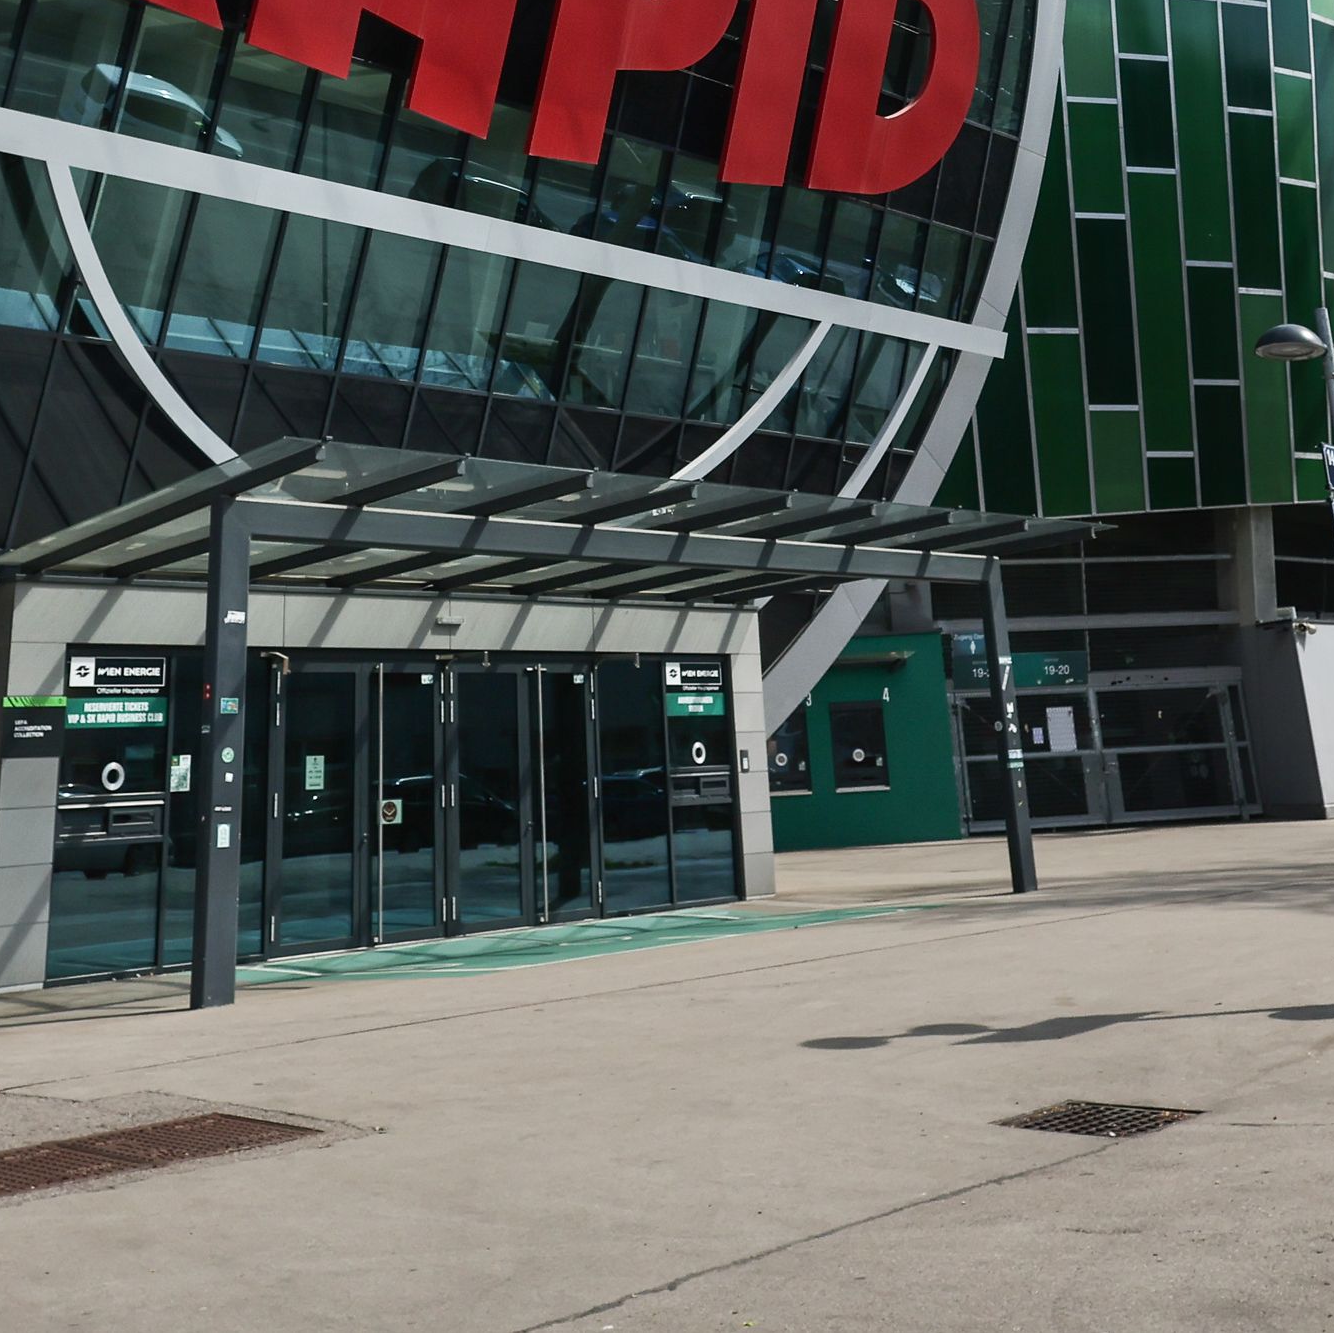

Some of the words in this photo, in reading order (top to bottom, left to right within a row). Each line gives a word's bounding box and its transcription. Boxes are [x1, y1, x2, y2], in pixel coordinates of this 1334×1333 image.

[97, 667, 121, 676] WIEN
[124, 667, 161, 676] ENERGIE
[1044, 665, 1070, 675] 19-20
[805, 692, 812, 707] 3
[883, 687, 890, 703] 4
[125, 702, 149, 712] TICKETS
[68, 714, 80, 724] VIP
[87, 714, 96, 723] SK
[97, 713, 116, 723] RAPID
[148, 712, 163, 722] CLUB
